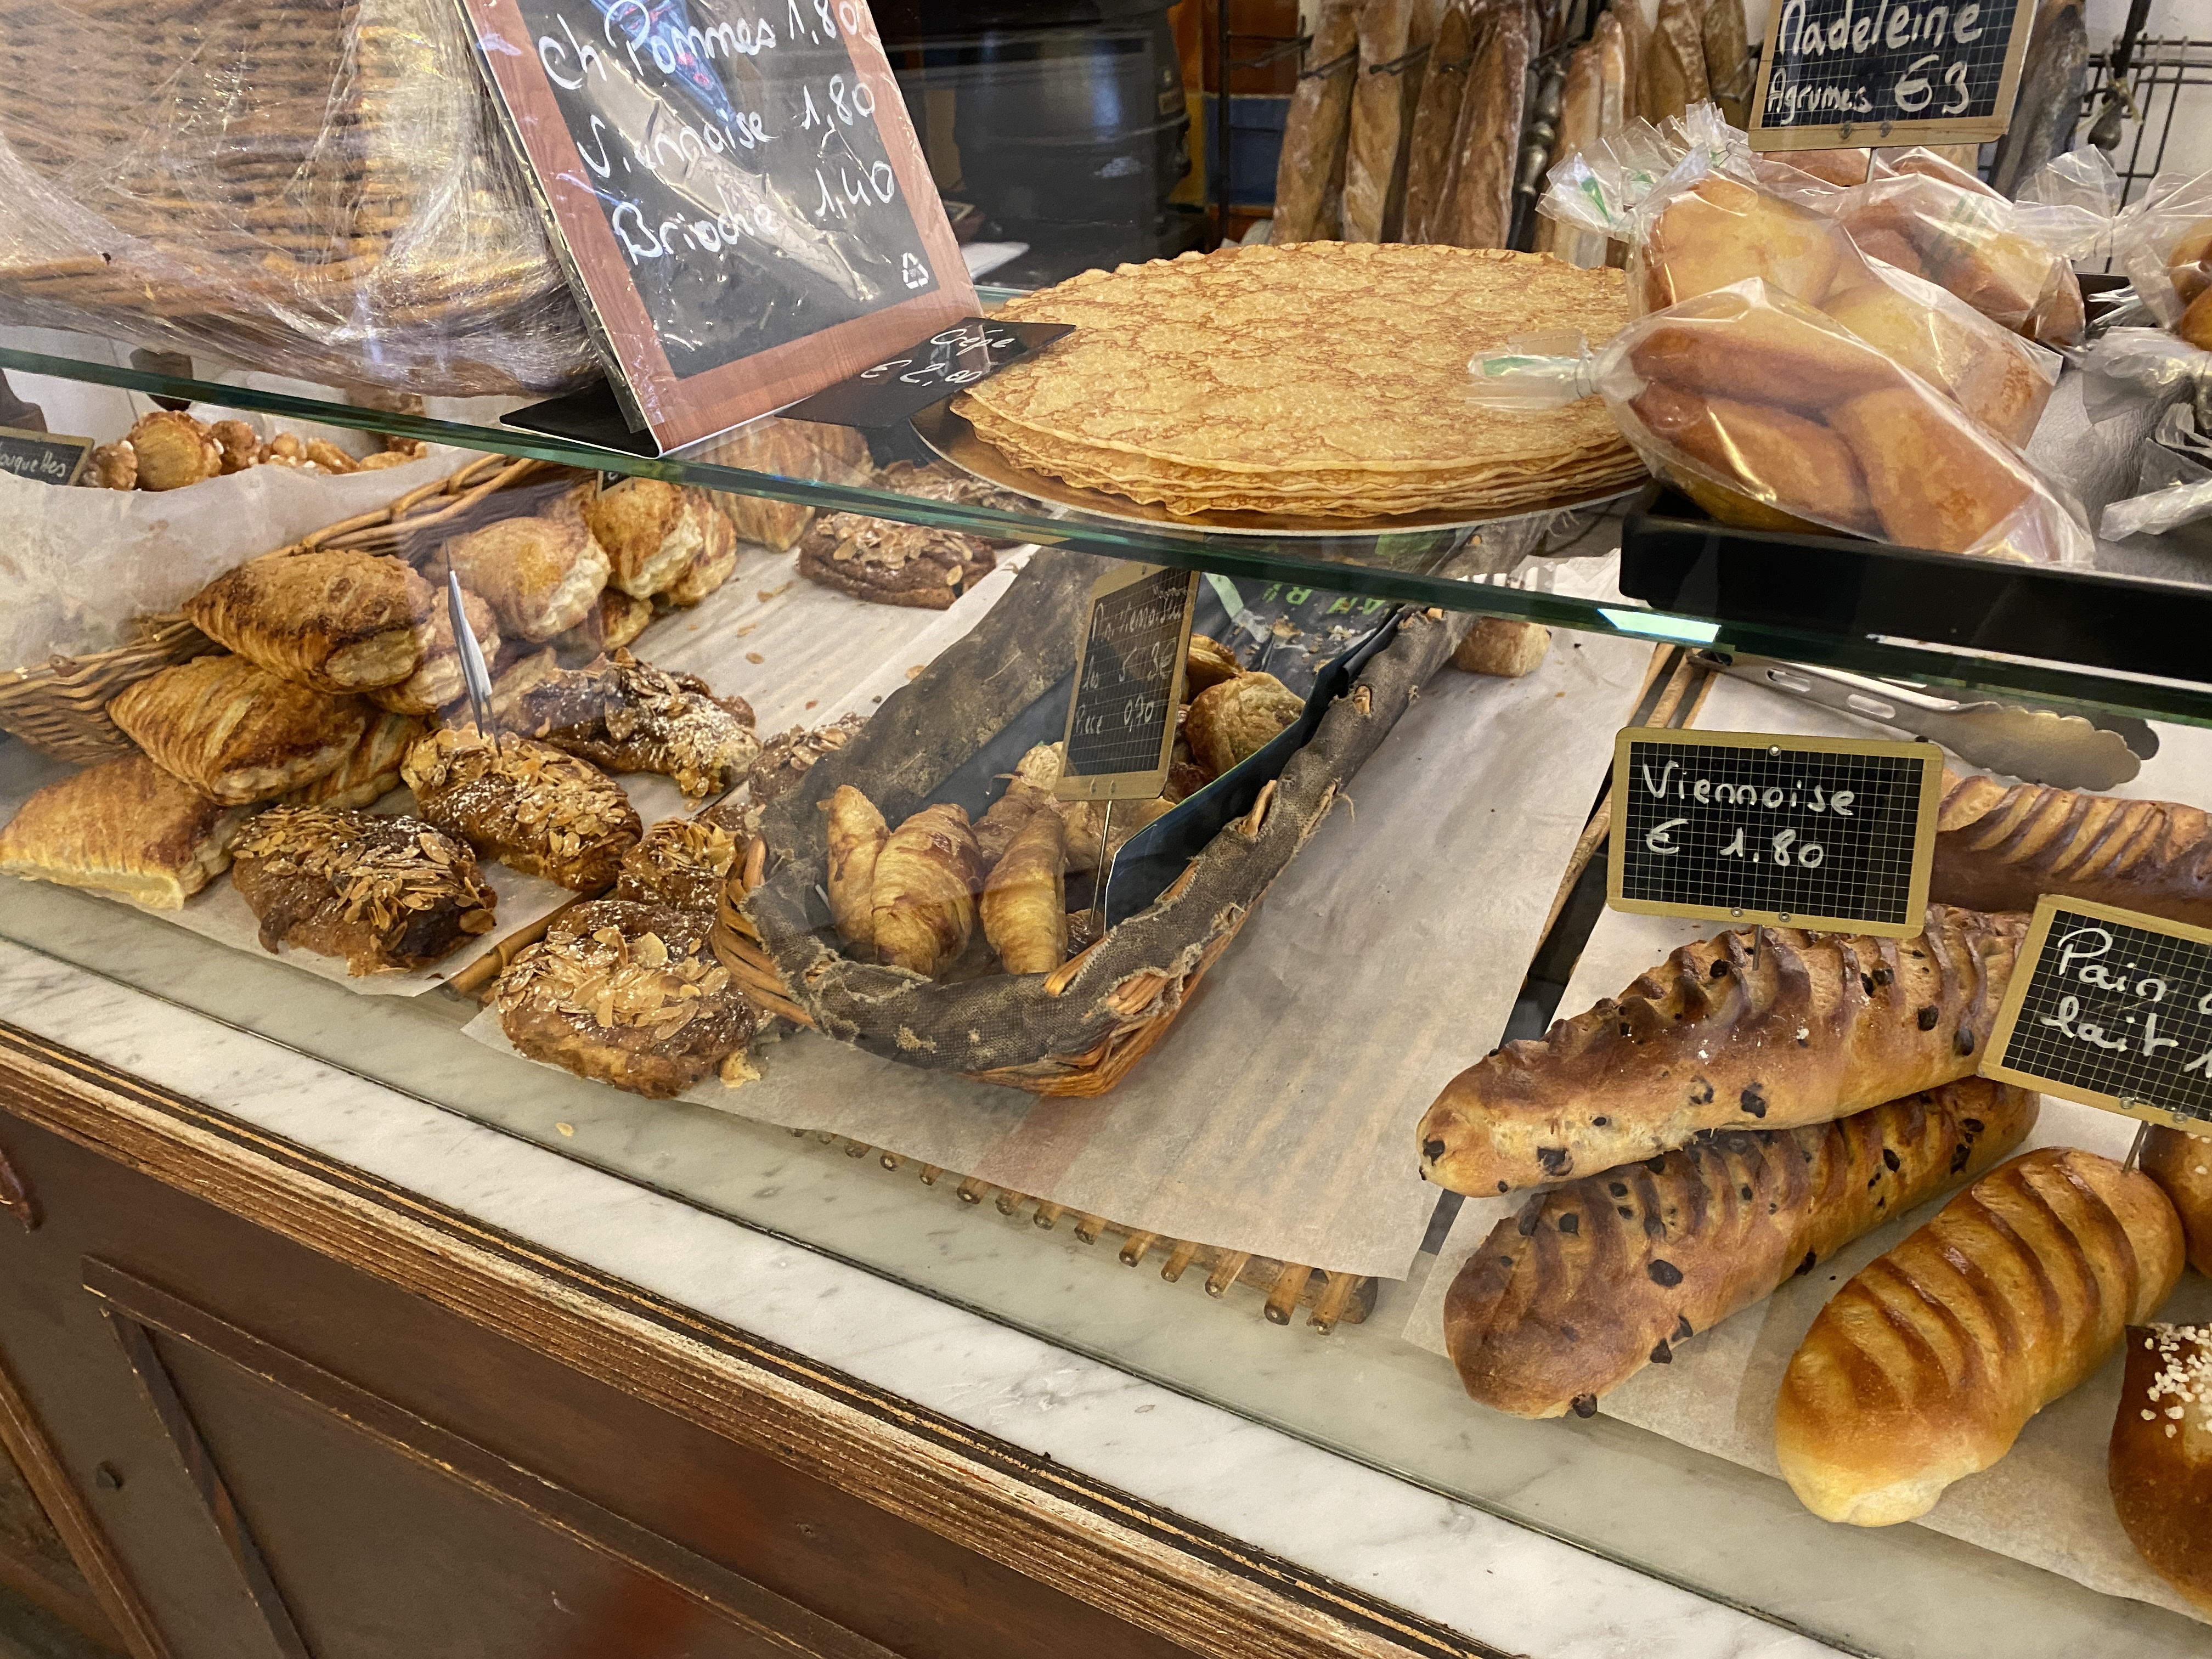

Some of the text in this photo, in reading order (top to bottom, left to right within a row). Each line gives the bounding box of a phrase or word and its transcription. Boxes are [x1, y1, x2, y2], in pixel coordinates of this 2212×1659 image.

[604, 0, 777, 76] Pommes
[801, 75, 876, 134] 1,80
[0, 450, 66, 478] ouquettes
[1643, 759, 1855, 816] Viennoise
[1645, 817, 1690, 855] €
[2057, 927, 2168, 1002] Pain
[2039, 995, 2179, 1057] lait
